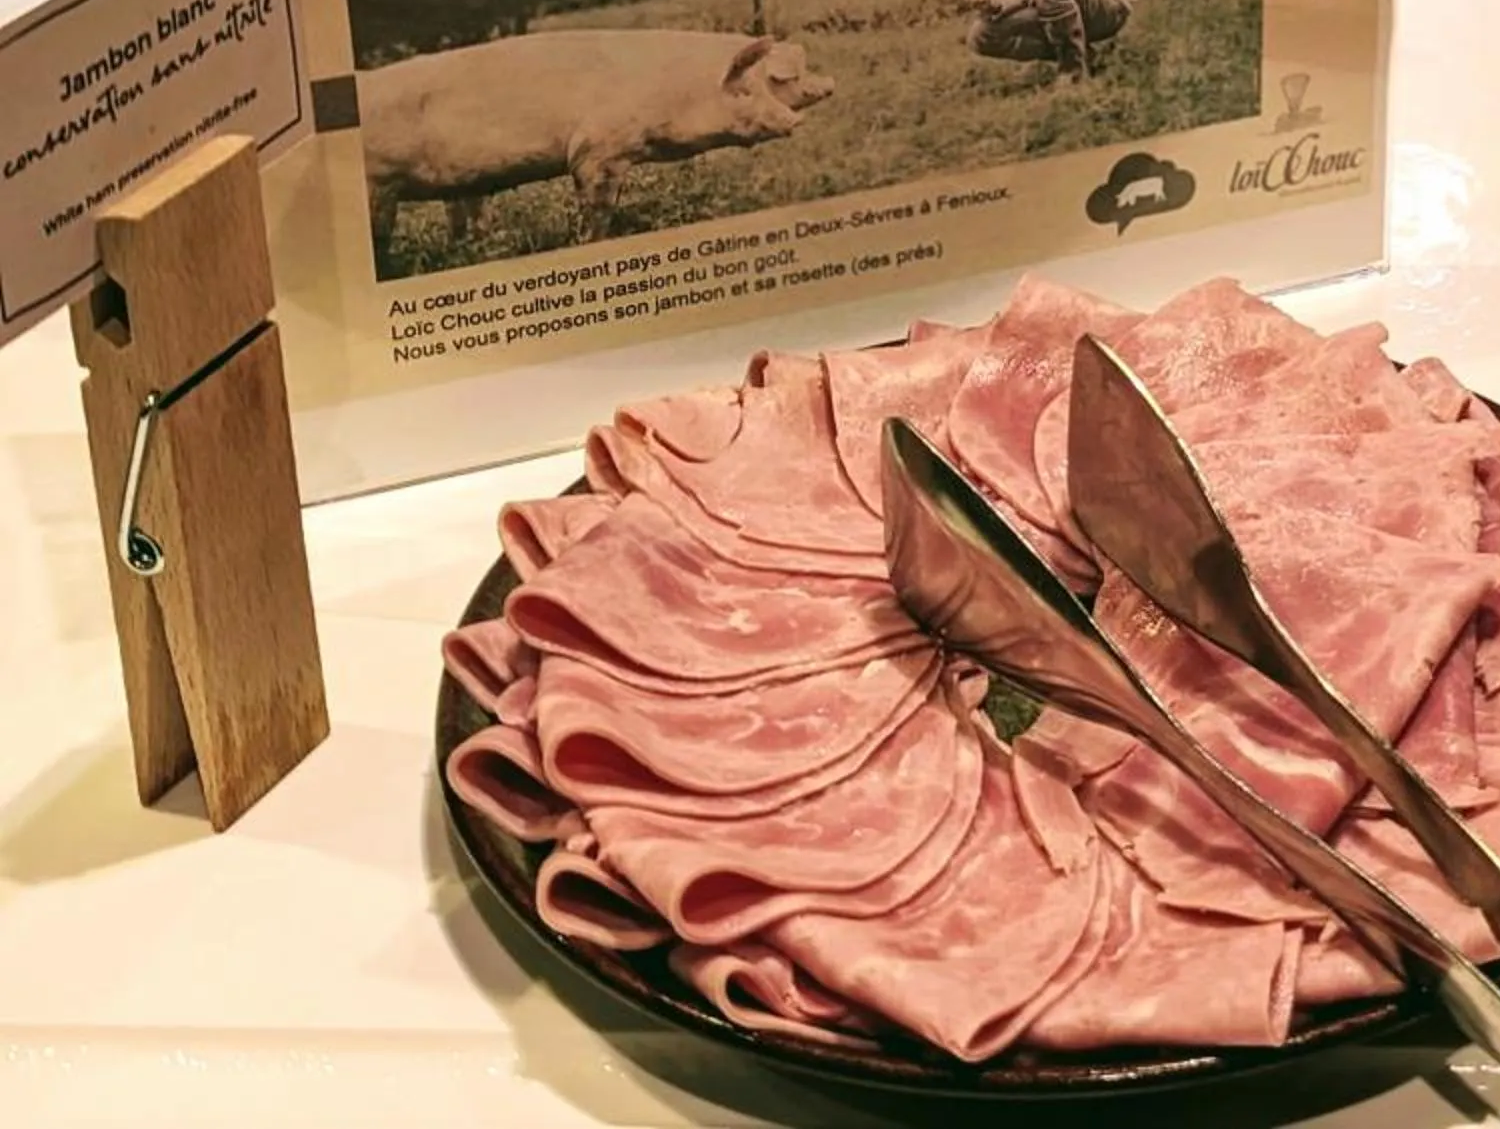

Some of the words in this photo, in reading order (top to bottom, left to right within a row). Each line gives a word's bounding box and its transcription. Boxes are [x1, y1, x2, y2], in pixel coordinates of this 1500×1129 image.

[3, 81, 145, 180] conservation
[150, 36, 212, 88] sans
[59, 30, 154, 103] Jambon
[41, 203, 84, 237] White
[85, 181, 116, 211] ham
[117, 129, 194, 192] preservation
[388, 299, 418, 318] Au
[422, 287, 479, 312] cœur
[481, 282, 508, 300] du
[512, 261, 612, 294] verdoyant
[614, 252, 662, 278] pays
[666, 246, 692, 263] de
[696, 234, 761, 257] Gâtine
[765, 229, 790, 245] en
[919, 198, 932, 215] à
[390, 320, 436, 342] Loïc
[440, 306, 507, 332] Chouc
[510, 293, 576, 319] cultive
[579, 287, 598, 304] la
[602, 272, 678, 304] passion
[682, 266, 708, 283] du
[712, 260, 749, 278] bon
[753, 248, 800, 274] goût.
[392, 341, 447, 363] Nous
[451, 329, 501, 352] vous
[505, 308, 610, 344] proposons
[613, 300, 650, 320] son
[654, 286, 726, 316] jambon
[730, 279, 749, 297] et
[754, 275, 777, 293] sa
[781, 261, 847, 287] rosette
[850, 252, 891, 276] (des
[895, 240, 944, 267] prés)
